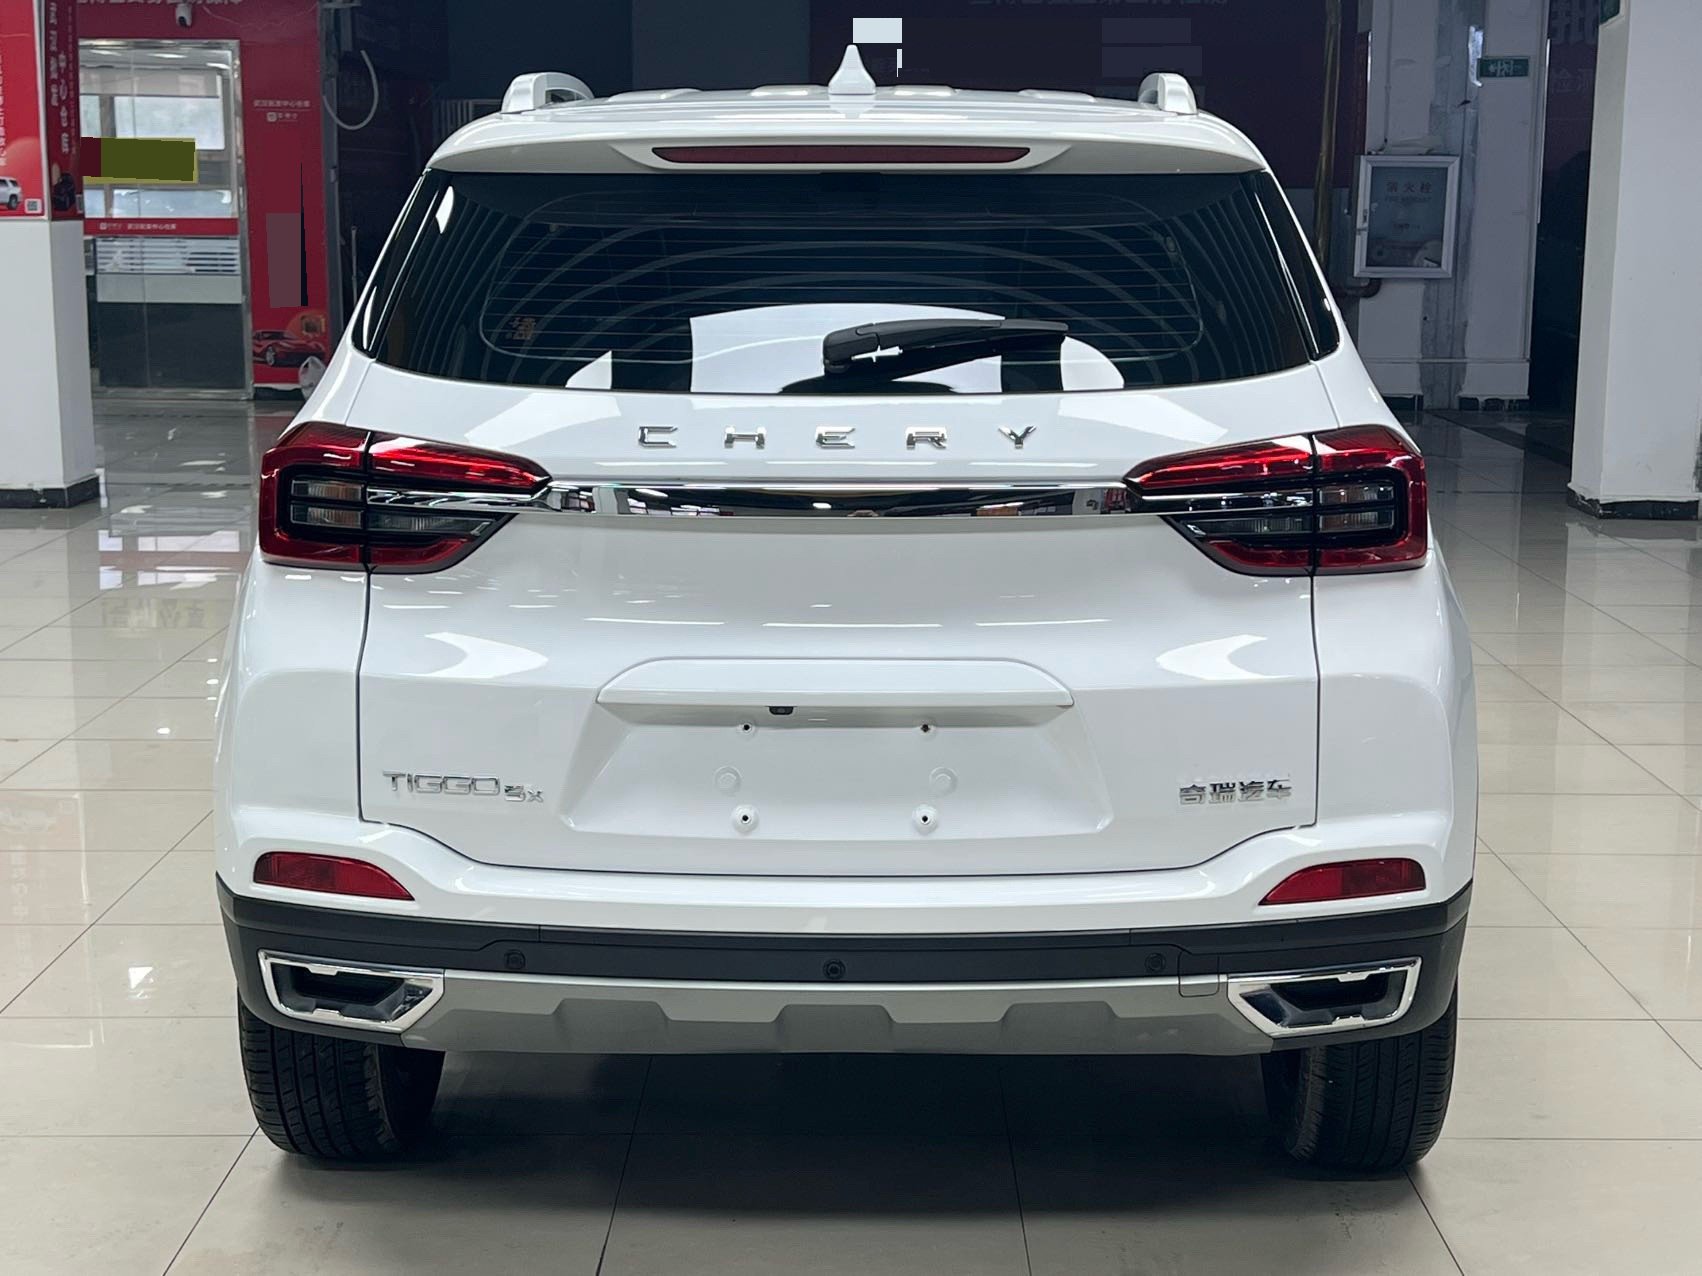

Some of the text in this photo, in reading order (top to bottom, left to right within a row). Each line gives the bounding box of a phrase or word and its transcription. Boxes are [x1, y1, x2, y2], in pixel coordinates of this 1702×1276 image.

[637, 425, 1038, 450] CHERY
[383, 770, 501, 796] TIGGO
[1179, 779, 1293, 805] 奇瑞汽车
